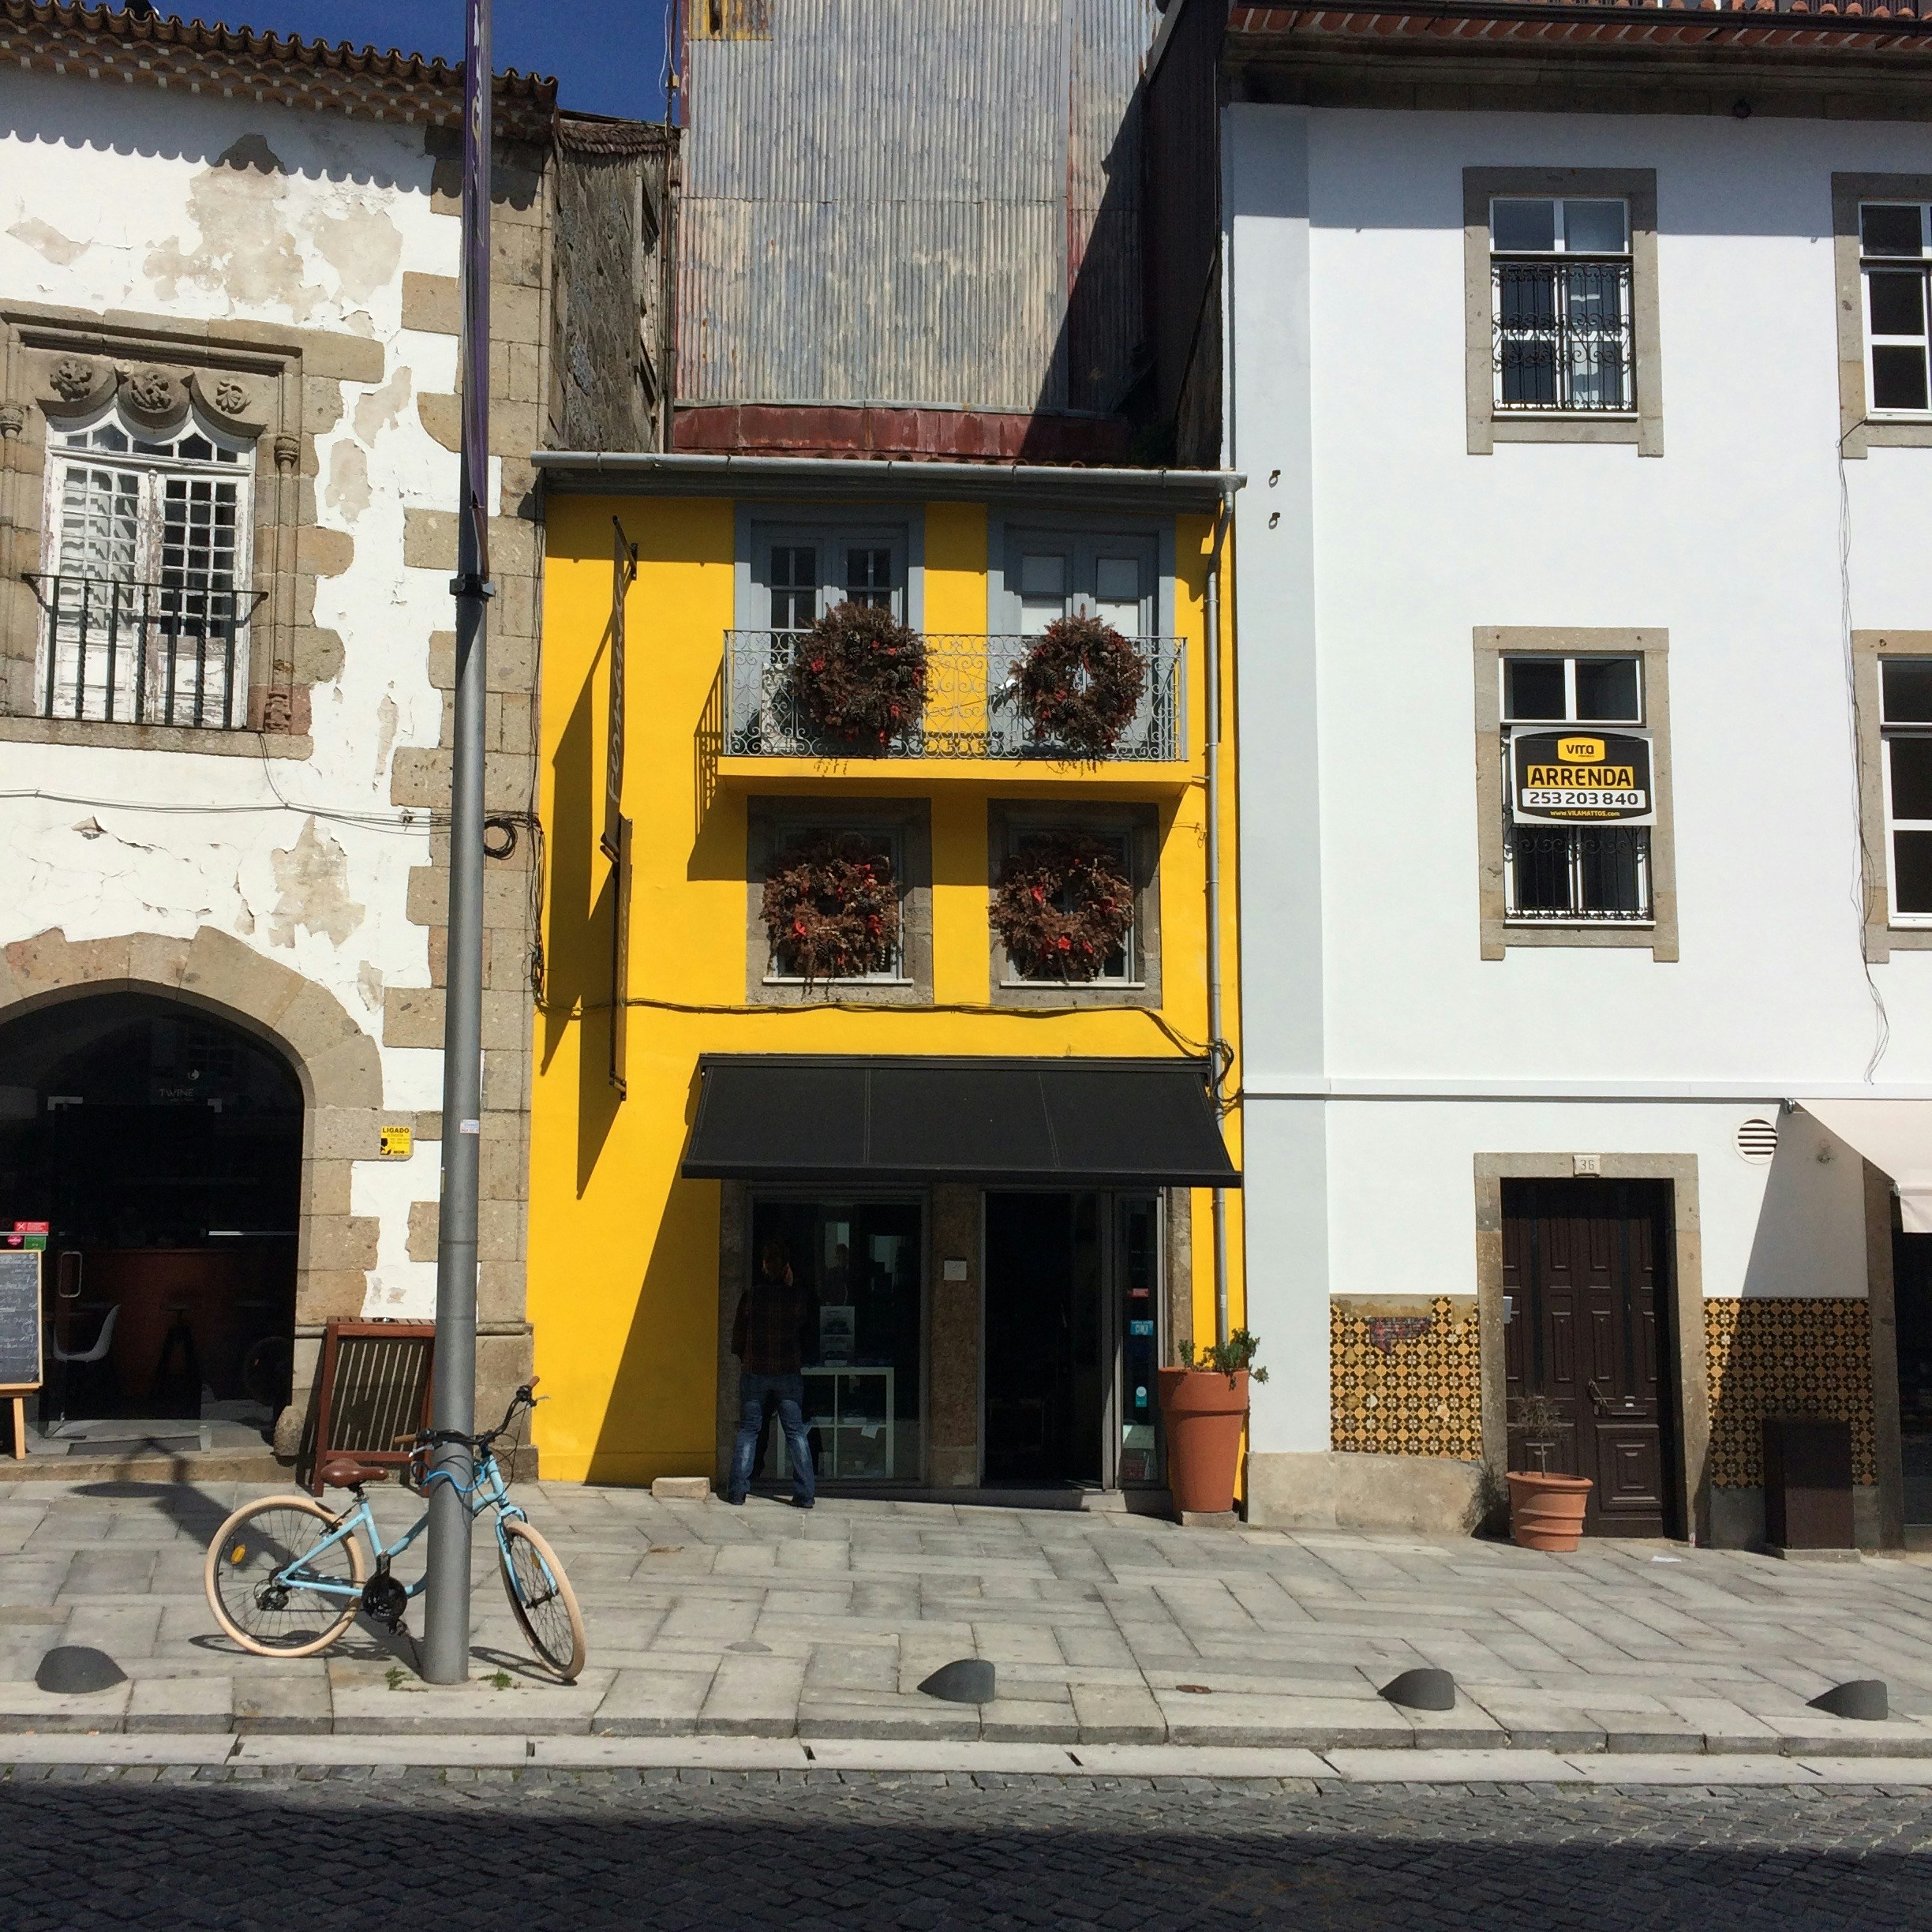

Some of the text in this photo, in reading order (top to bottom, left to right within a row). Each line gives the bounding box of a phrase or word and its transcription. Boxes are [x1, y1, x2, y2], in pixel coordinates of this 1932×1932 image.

[608, 572, 624, 803] Fernando
[1530, 767, 1631, 787] ARRENDA
[1530, 792, 1638, 805] 253 203 840
[1579, 1159, 1594, 1170] 36
